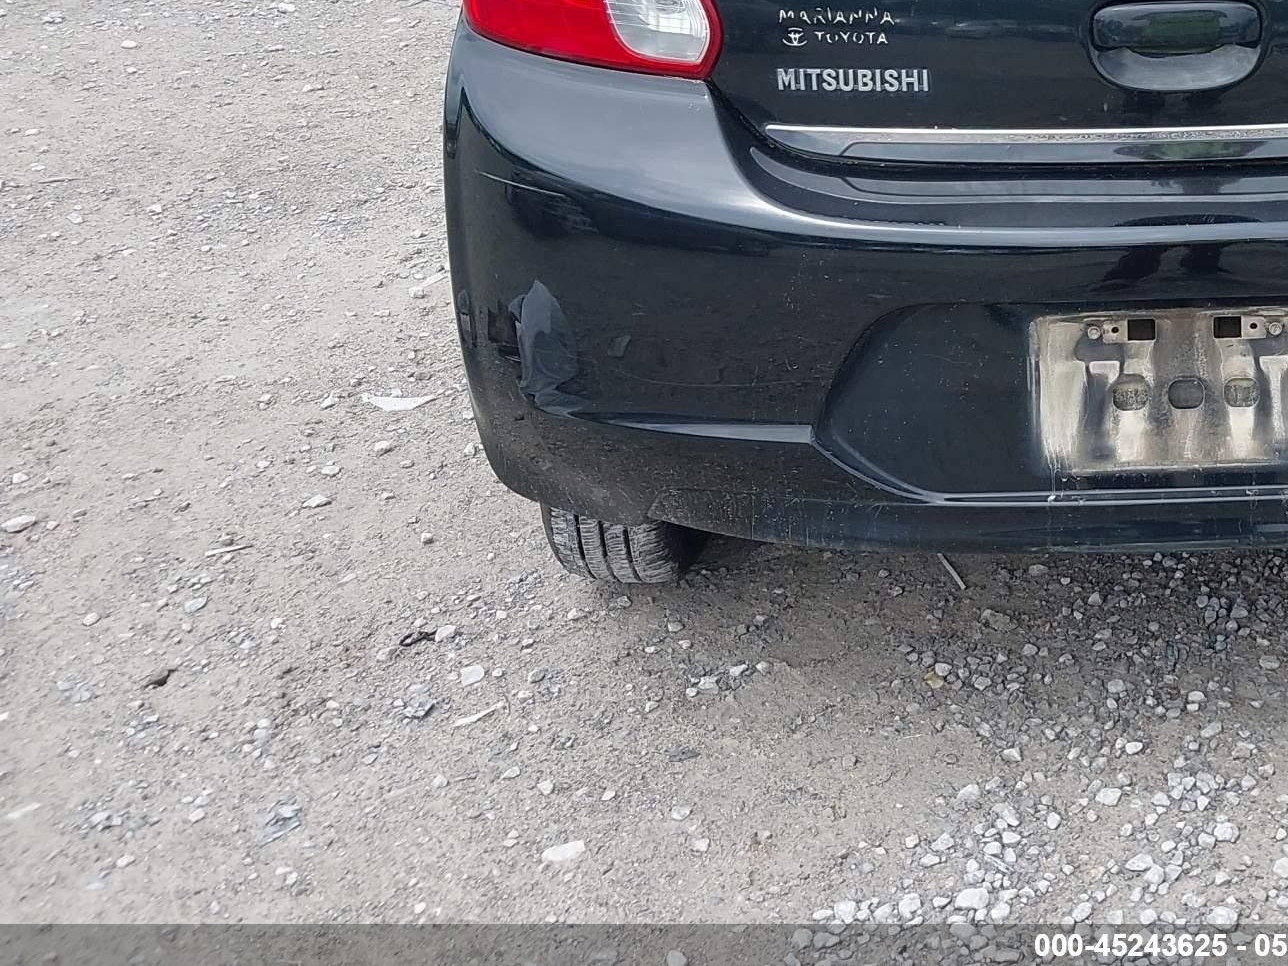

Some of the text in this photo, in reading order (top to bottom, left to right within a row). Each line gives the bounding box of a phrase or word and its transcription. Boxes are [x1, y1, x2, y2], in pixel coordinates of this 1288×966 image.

[779, 7, 895, 25] MARIANNA
[813, 31, 889, 45] TOYOTA
[776, 68, 930, 92] MITSUBISHI
